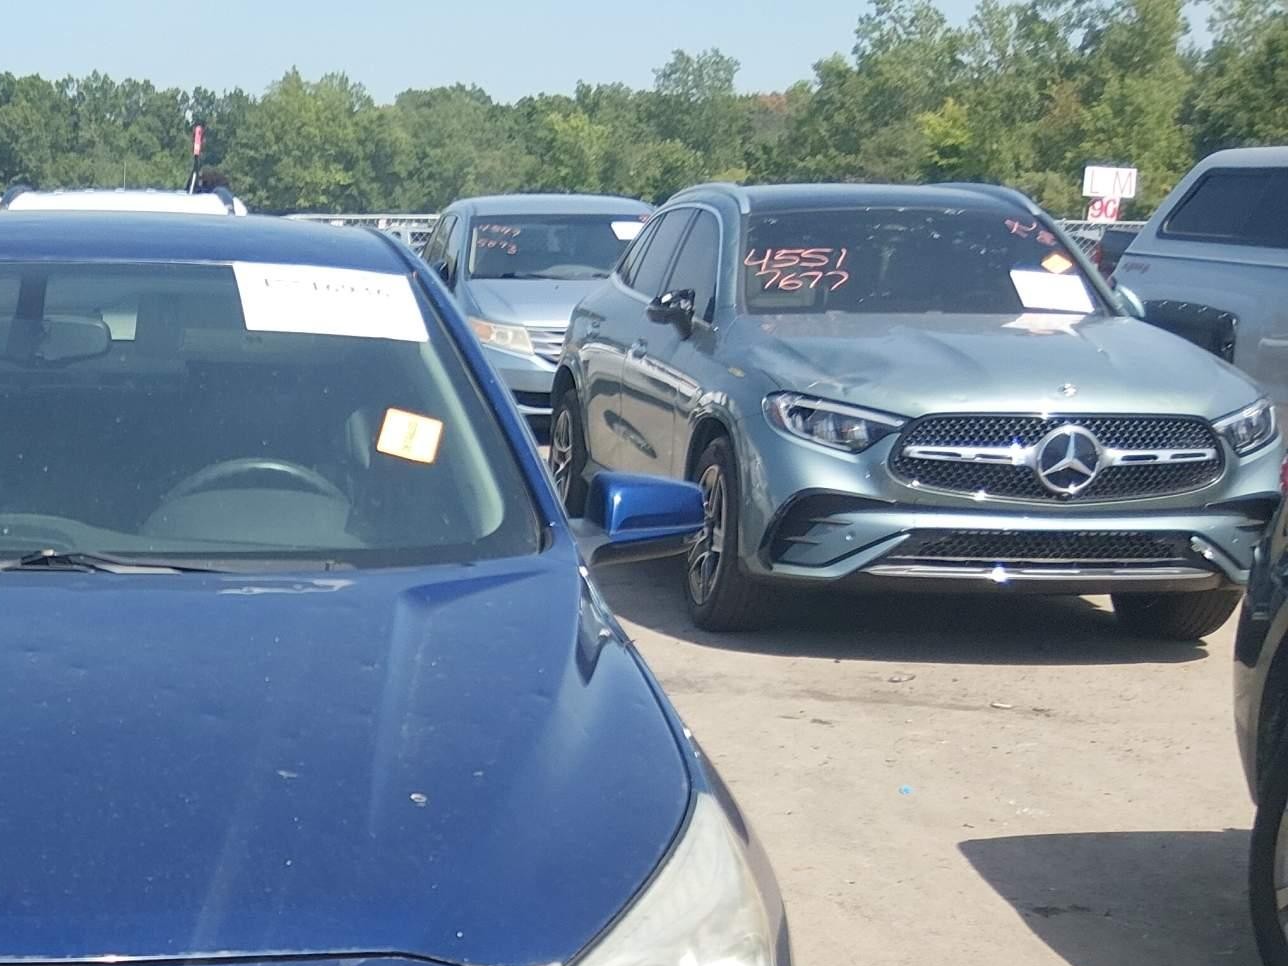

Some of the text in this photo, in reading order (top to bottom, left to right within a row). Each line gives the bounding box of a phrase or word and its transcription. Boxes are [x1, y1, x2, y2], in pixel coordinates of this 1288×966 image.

[1112, 170, 1133, 195] M
[744, 247, 848, 273] 4551
[755, 269, 849, 291] 7677
